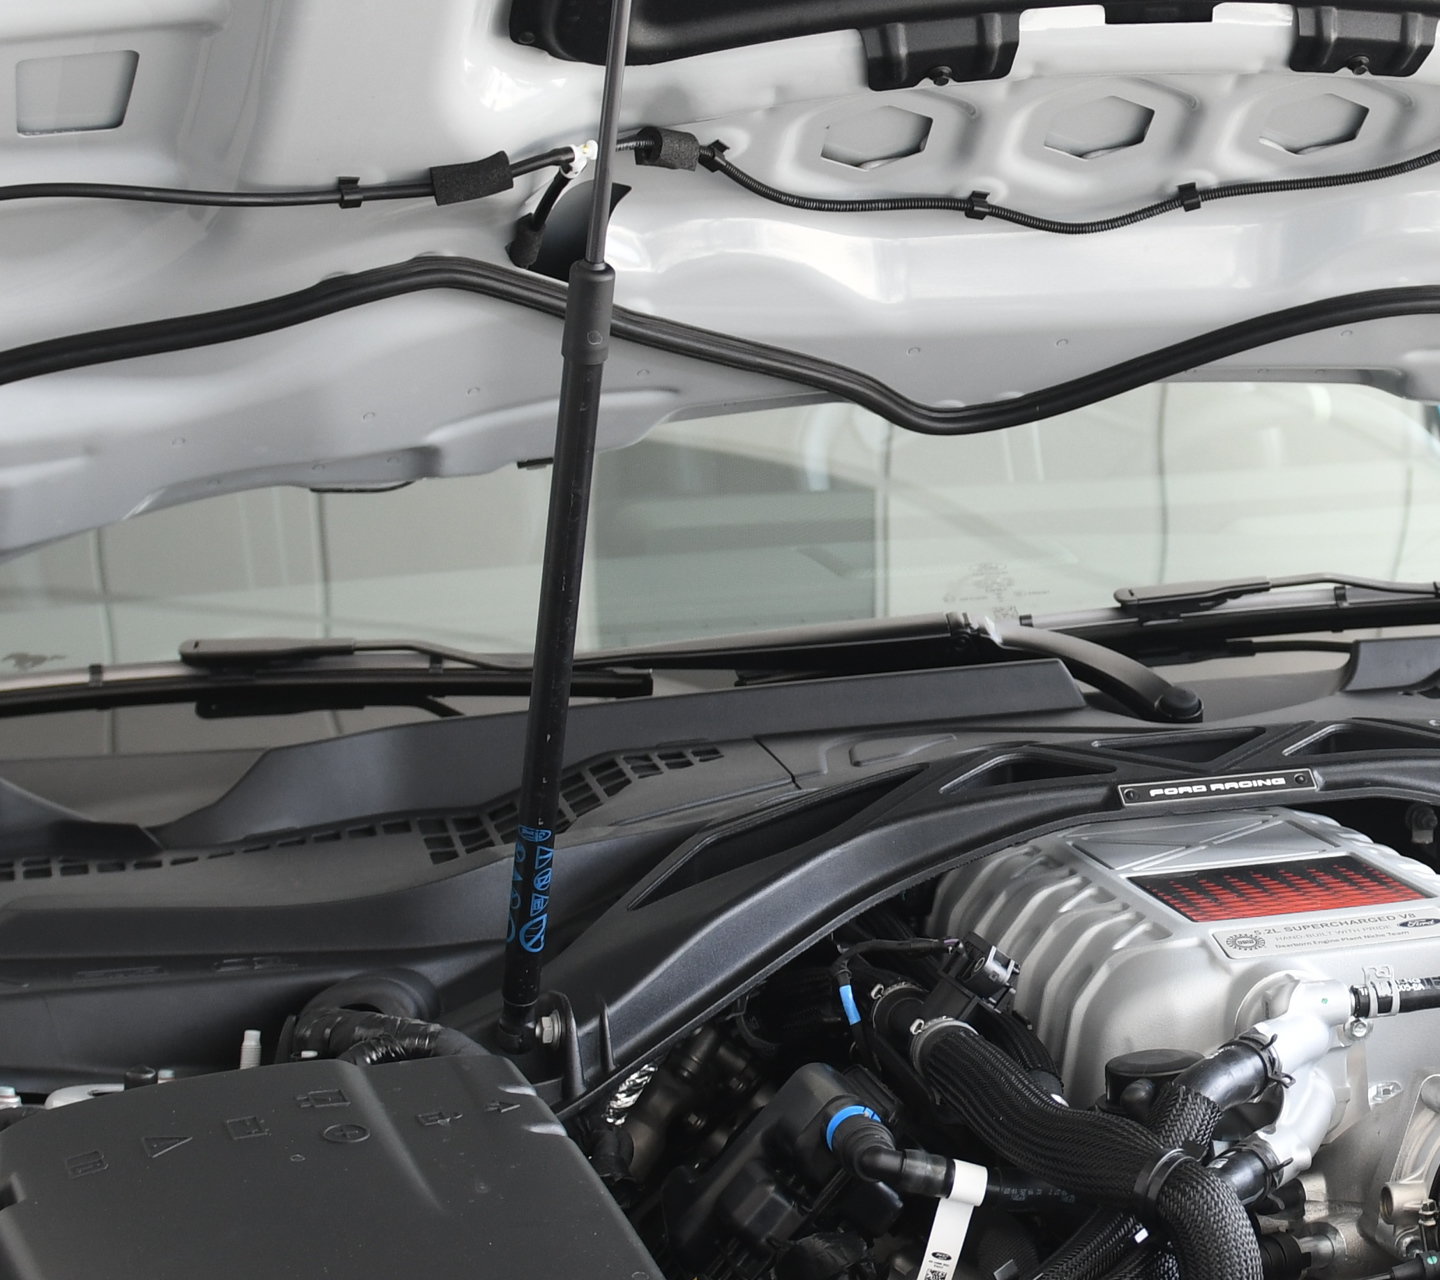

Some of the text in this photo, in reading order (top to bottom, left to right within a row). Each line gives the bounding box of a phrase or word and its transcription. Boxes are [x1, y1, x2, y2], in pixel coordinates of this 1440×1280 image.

[1149, 778, 1286, 797] FORD RACING
[1253, 928, 1281, 936] 5.2L
[1284, 914, 1396, 933] SUPERCHARGED
[1336, 928, 1361, 936] WITH
[1362, 925, 1391, 933] PRIDE
[1275, 940, 1311, 949] Dearborn
[1313, 938, 1339, 947] Engine
[1341, 935, 1362, 943] Plant
